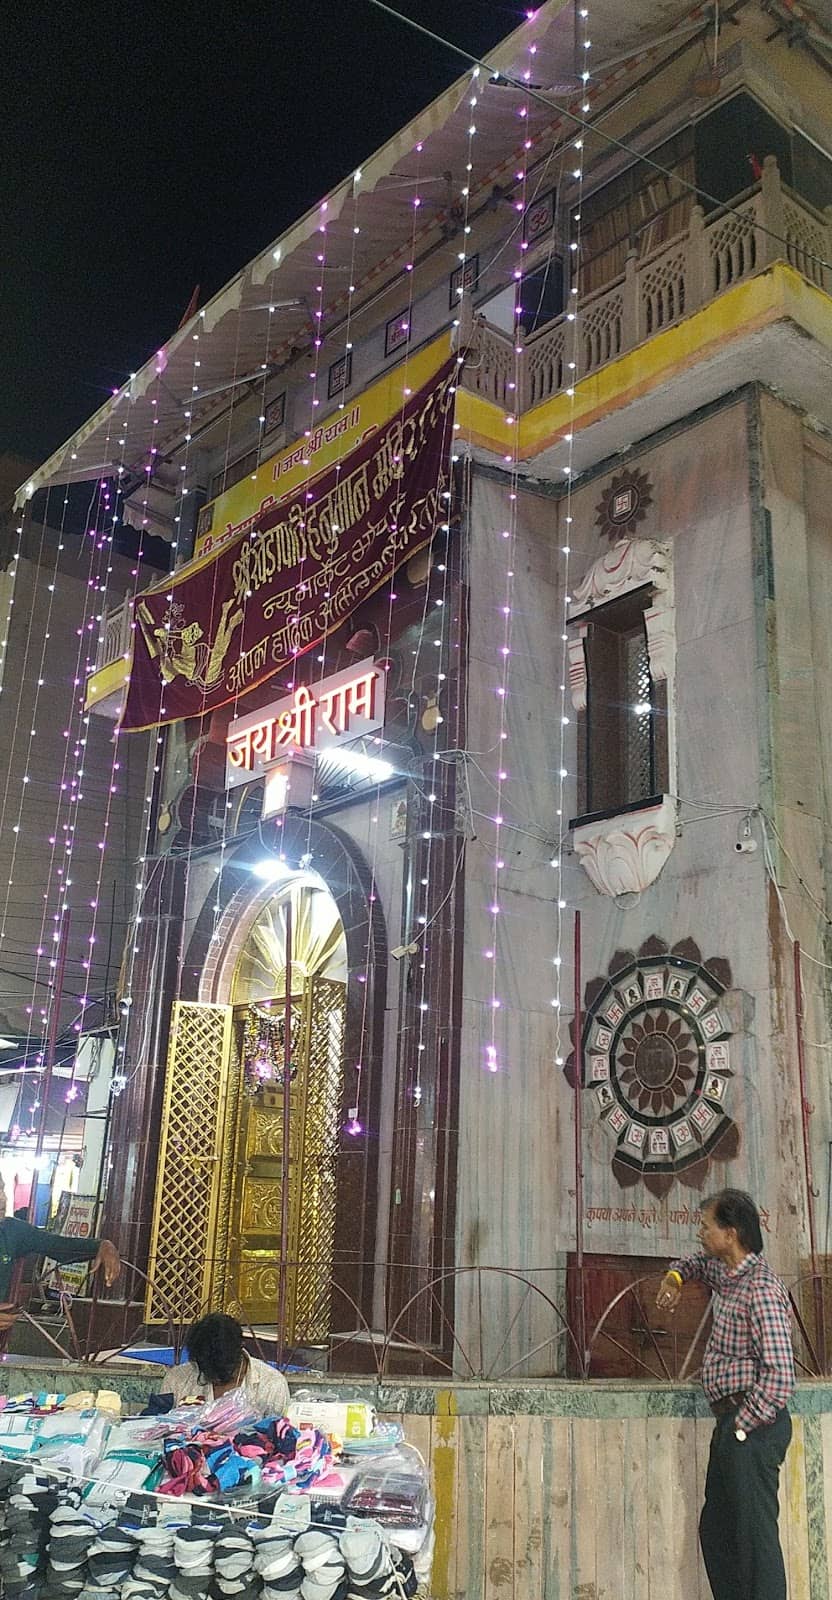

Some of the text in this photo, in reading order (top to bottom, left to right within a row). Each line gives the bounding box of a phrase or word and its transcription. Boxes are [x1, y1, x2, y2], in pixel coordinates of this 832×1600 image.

[306, 429, 324, 457] श्री
[325, 418, 348, 443] राम
[226, 672, 379, 770] जय श्री राम
